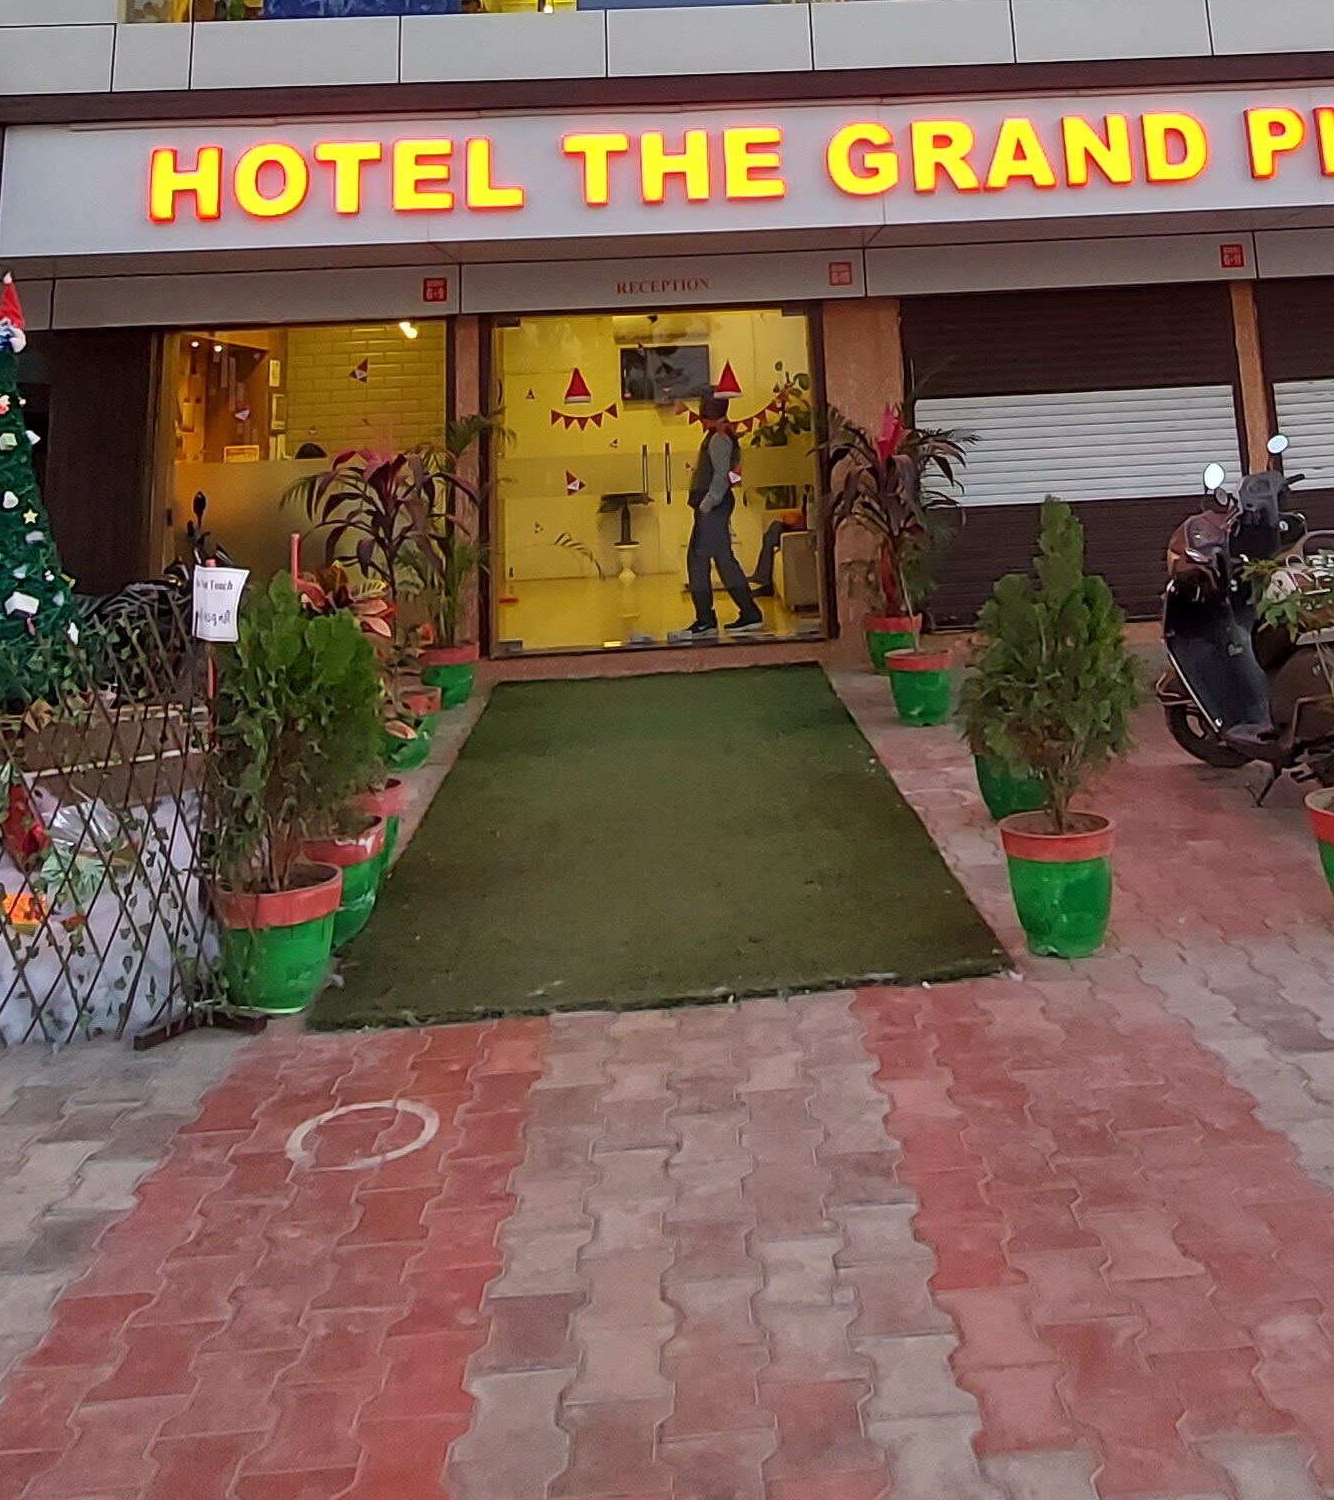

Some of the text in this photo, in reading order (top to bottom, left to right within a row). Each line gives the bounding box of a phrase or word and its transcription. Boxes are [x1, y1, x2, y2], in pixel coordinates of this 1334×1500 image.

[148, 136, 525, 222] HOTEL
[562, 125, 786, 205] THE
[826, 112, 1210, 196] GRAND
[616, 277, 710, 295] RECEPTION
